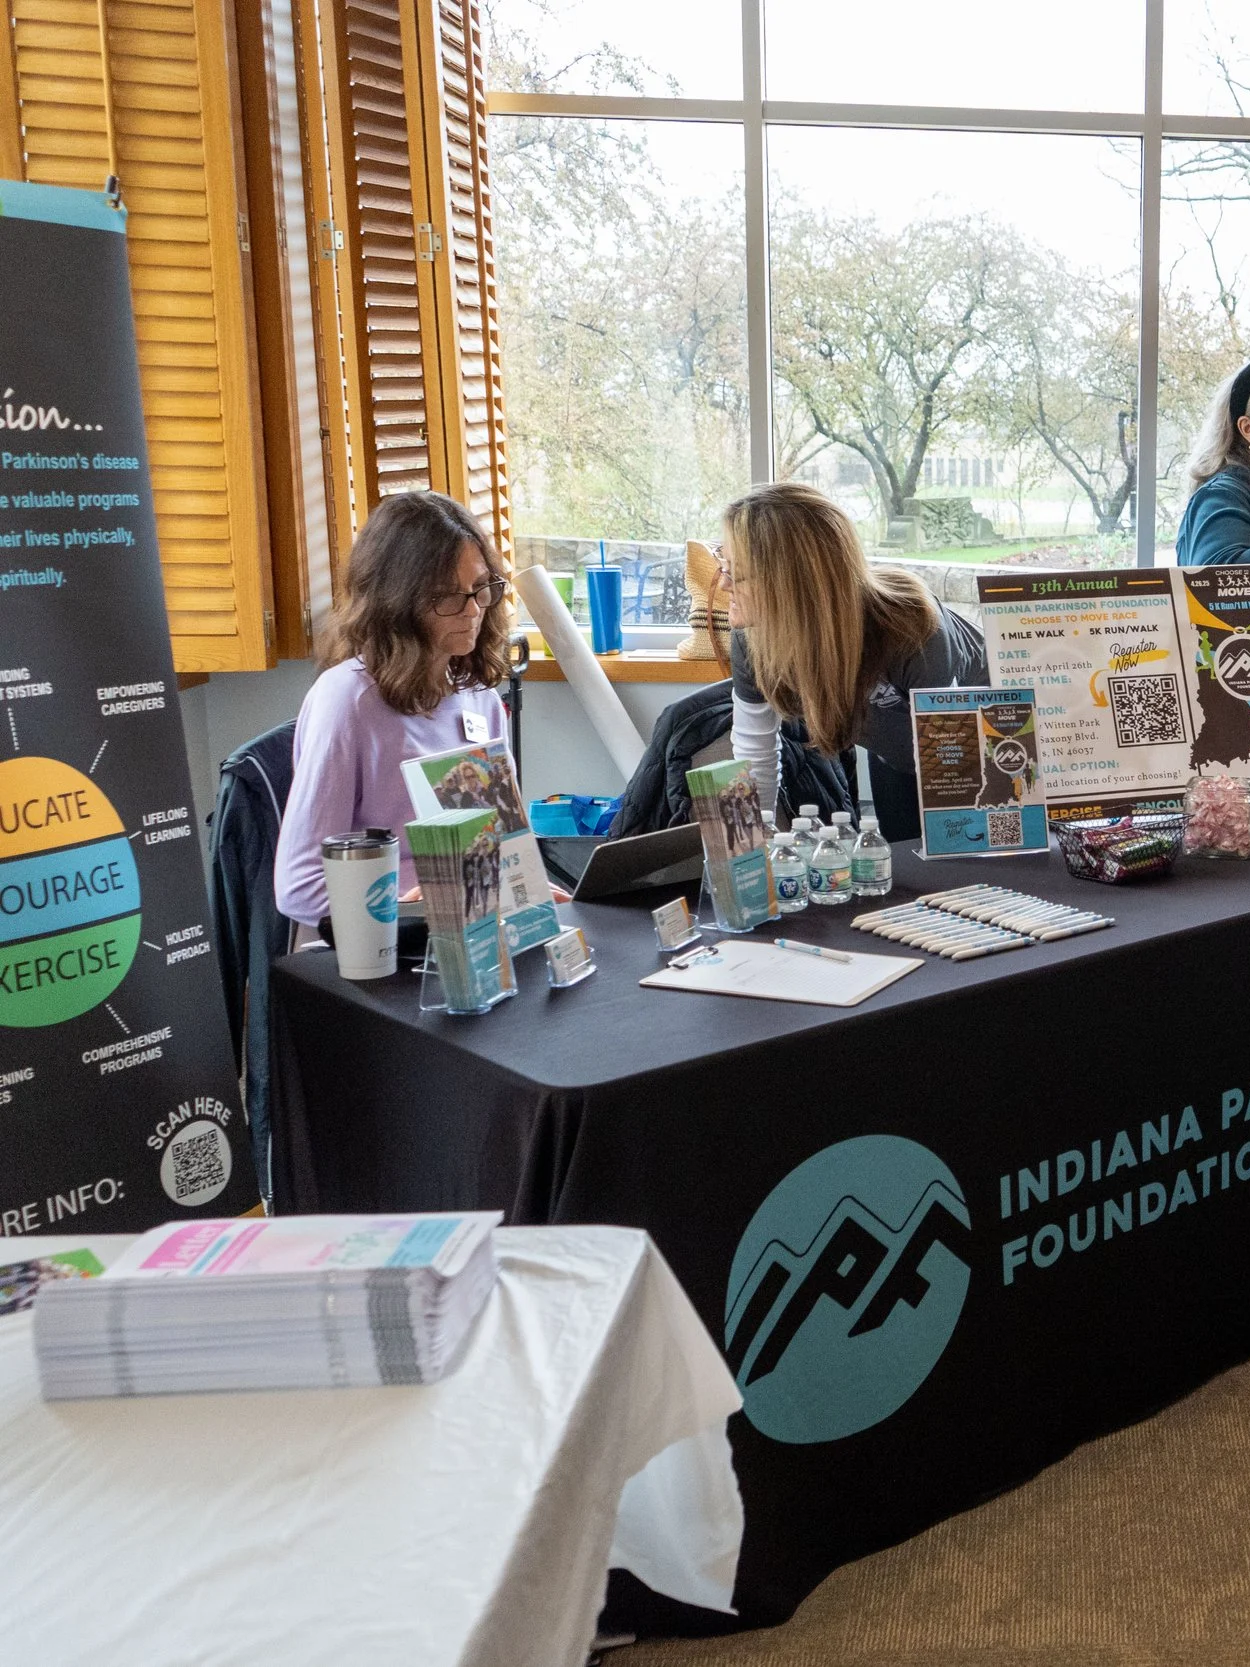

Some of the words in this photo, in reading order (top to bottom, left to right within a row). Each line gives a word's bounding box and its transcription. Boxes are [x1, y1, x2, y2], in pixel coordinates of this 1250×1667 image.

[2, 452, 89, 469] Parkinson's
[93, 453, 140, 469] disease
[12, 491, 75, 508] valuable
[79, 493, 139, 511] programs
[25, 529, 60, 546] lives
[64, 528, 135, 549] physically,
[1032, 579, 1061, 595] 13th
[1065, 577, 1118, 591] Annual
[985, 605, 1031, 615] INDIANA
[1035, 602, 1096, 613] PARKINSON
[1101, 598, 1168, 609] FOUNDATION
[1020, 616, 1061, 625] CHOOSE
[1065, 615, 1078, 623] TO
[1081, 613, 1109, 622] MOVE
[1112, 612, 1138, 620] RACE
[1009, 631, 1032, 639] MILE
[1036, 629, 1065, 638] WALK
[1090, 628, 1102, 636] 5K
[1105, 624, 1159, 635] RUN/WALK
[998, 650, 1031, 660] DATE:
[1110, 638, 1157, 661] Register
[1000, 663, 1043, 674] Saturday
[1045, 662, 1069, 672] April
[1072, 661, 1093, 669] 26th
[1114, 655, 1139, 674] Now
[1001, 677, 1034, 686] RACE
[1040, 675, 1072, 685] TIME:
[6, 682, 53, 699] SYSTEMS
[97, 681, 165, 700] EMPOWERING
[929, 694, 969, 704] YOU'RE
[973, 692, 1022, 702] INVITED!
[101, 697, 165, 716] CAREGIVERS
[1044, 720, 1078, 729] Witten
[1080, 719, 1101, 728] Park
[1076, 732, 1099, 740] Blvd.
[1052, 748, 1064, 756] IN
[1067, 746, 1094, 756] 46037
[1070, 760, 1120, 771] OPTION:
[1061, 776, 1099, 786] location
[1102, 775, 1112, 784] of
[1113, 776, 1135, 786] your
[1137, 770, 1182, 782] choosing!
[143, 807, 188, 826] LIFELONG
[1048, 806, 1102, 819] ERCISE
[145, 825, 191, 845] LEARNING
[1, 862, 124, 915] OURAGE
[166, 925, 203, 946] HOLISTIC
[166, 941, 210, 966] APPROACH
[82, 1026, 172, 1064] COMPREHENSIVE
[100, 1047, 163, 1075] PROGRAMS
[147, 1102, 191, 1150] SCAN
[195, 1097, 232, 1126] HERE
[1000, 1105, 1204, 1220] INDIANA
[47, 1178, 125, 1223] INFO:
